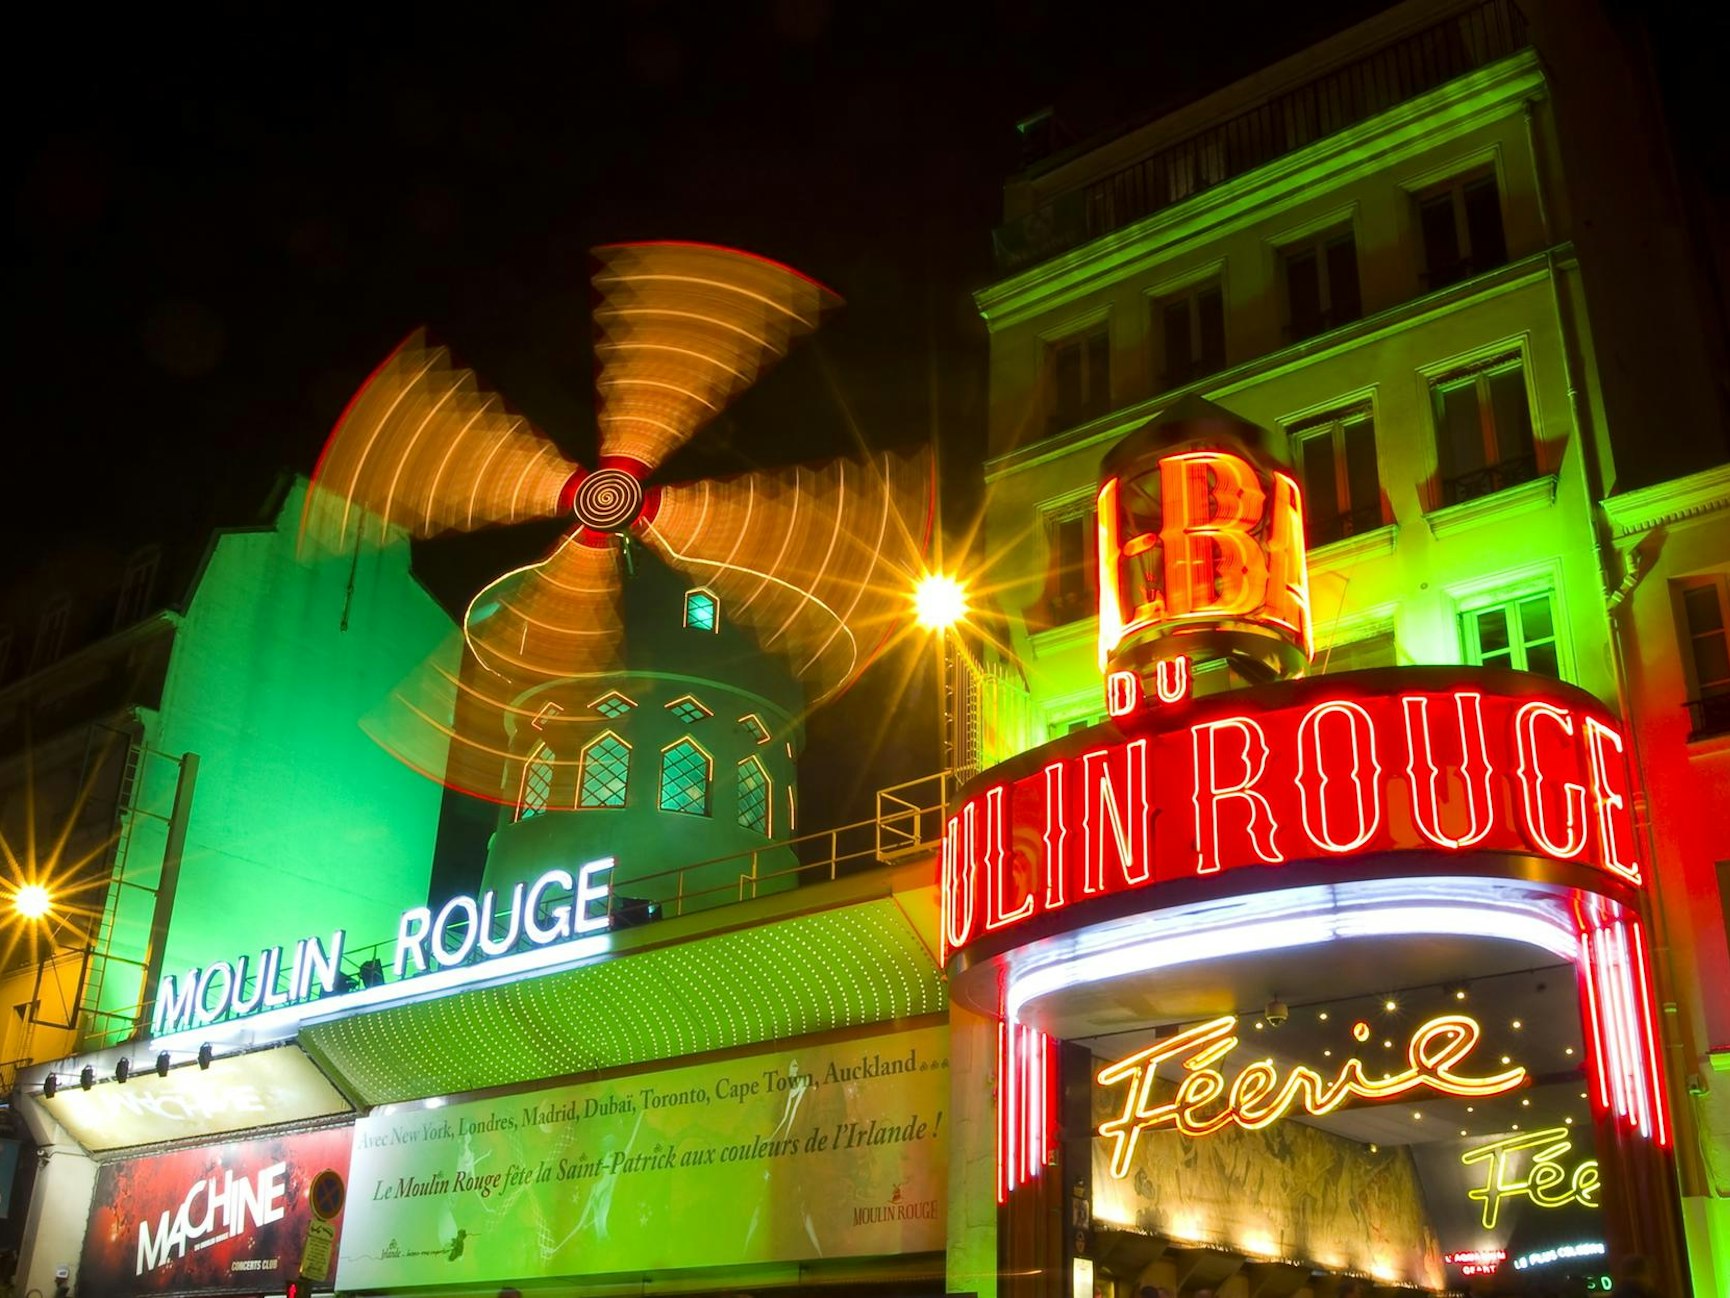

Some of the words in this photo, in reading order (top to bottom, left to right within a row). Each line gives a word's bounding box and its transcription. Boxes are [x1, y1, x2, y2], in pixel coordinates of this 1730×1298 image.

[1108, 655, 1187, 717] DU
[940, 739, 1149, 968] ULIN
[1191, 693, 1642, 884] ROUGE
[154, 929, 346, 1033] MOULIN
[395, 856, 616, 975] ROUGE
[358, 1132, 390, 1150] Avec
[391, 1126, 419, 1145] New
[422, 1122, 455, 1142] York,
[458, 1115, 518, 1136] Londres,
[521, 1104, 580, 1128] Madrid,
[583, 1095, 636, 1119] Dubaï,
[640, 1089, 711, 1110] Toronto,
[715, 1078, 759, 1103] Cape
[763, 1070, 820, 1093] Town,
[1097, 1015, 1526, 1178] Féerie
[373, 1179, 393, 1201] Le
[394, 1173, 449, 1198] Moulin
[452, 1171, 501, 1197] Rouge
[499, 1164, 533, 1196] fête
[535, 1161, 553, 1184] la
[556, 1145, 675, 1182] Saint-Patrick
[680, 1149, 716, 1167] aux
[720, 1135, 800, 1162] couleurs
[804, 1127, 828, 1153] de
[136, 1161, 286, 1276] MACHINE
[853, 1205, 895, 1226] MOULIN
[897, 1200, 938, 1221] ROUGE
